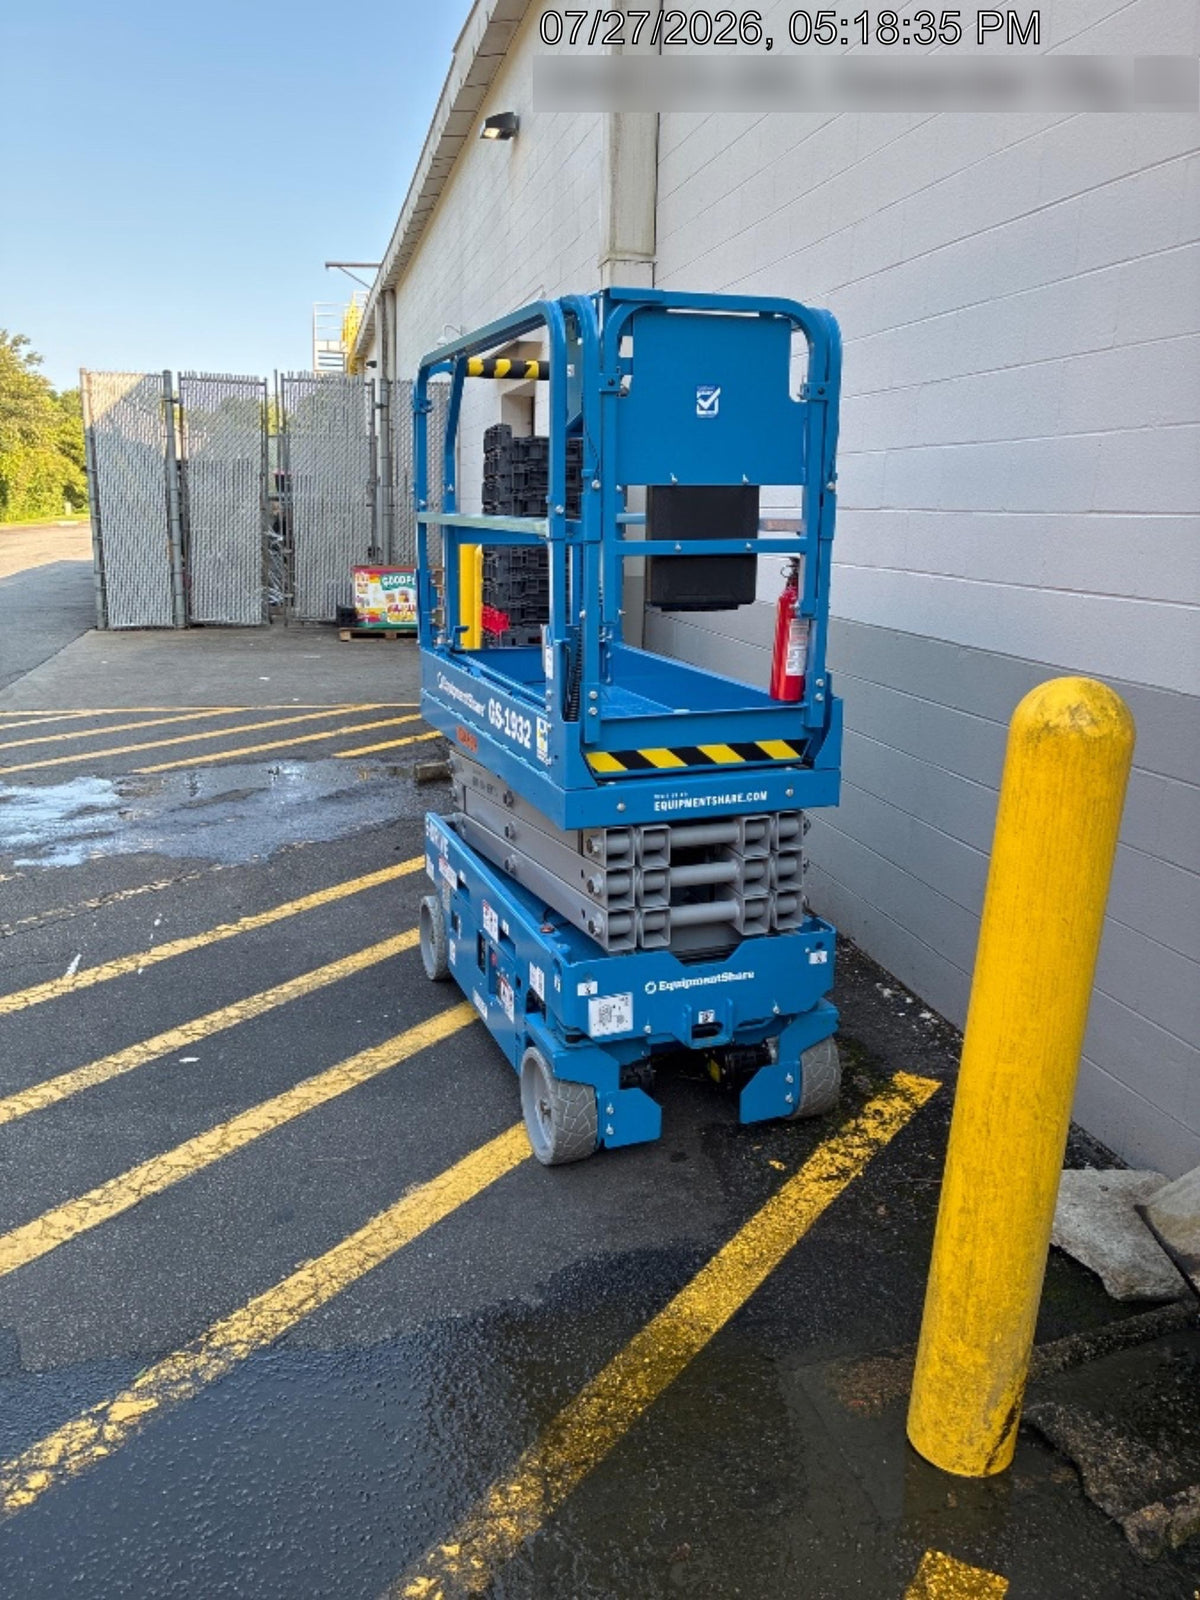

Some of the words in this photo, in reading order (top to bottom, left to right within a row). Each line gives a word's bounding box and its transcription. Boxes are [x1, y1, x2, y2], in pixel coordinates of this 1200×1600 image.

[488, 698, 532, 749] GS-1932
[654, 790, 768, 812] EQUIPMENTSHARE.COM
[658, 971, 755, 991] EquipmentShare
